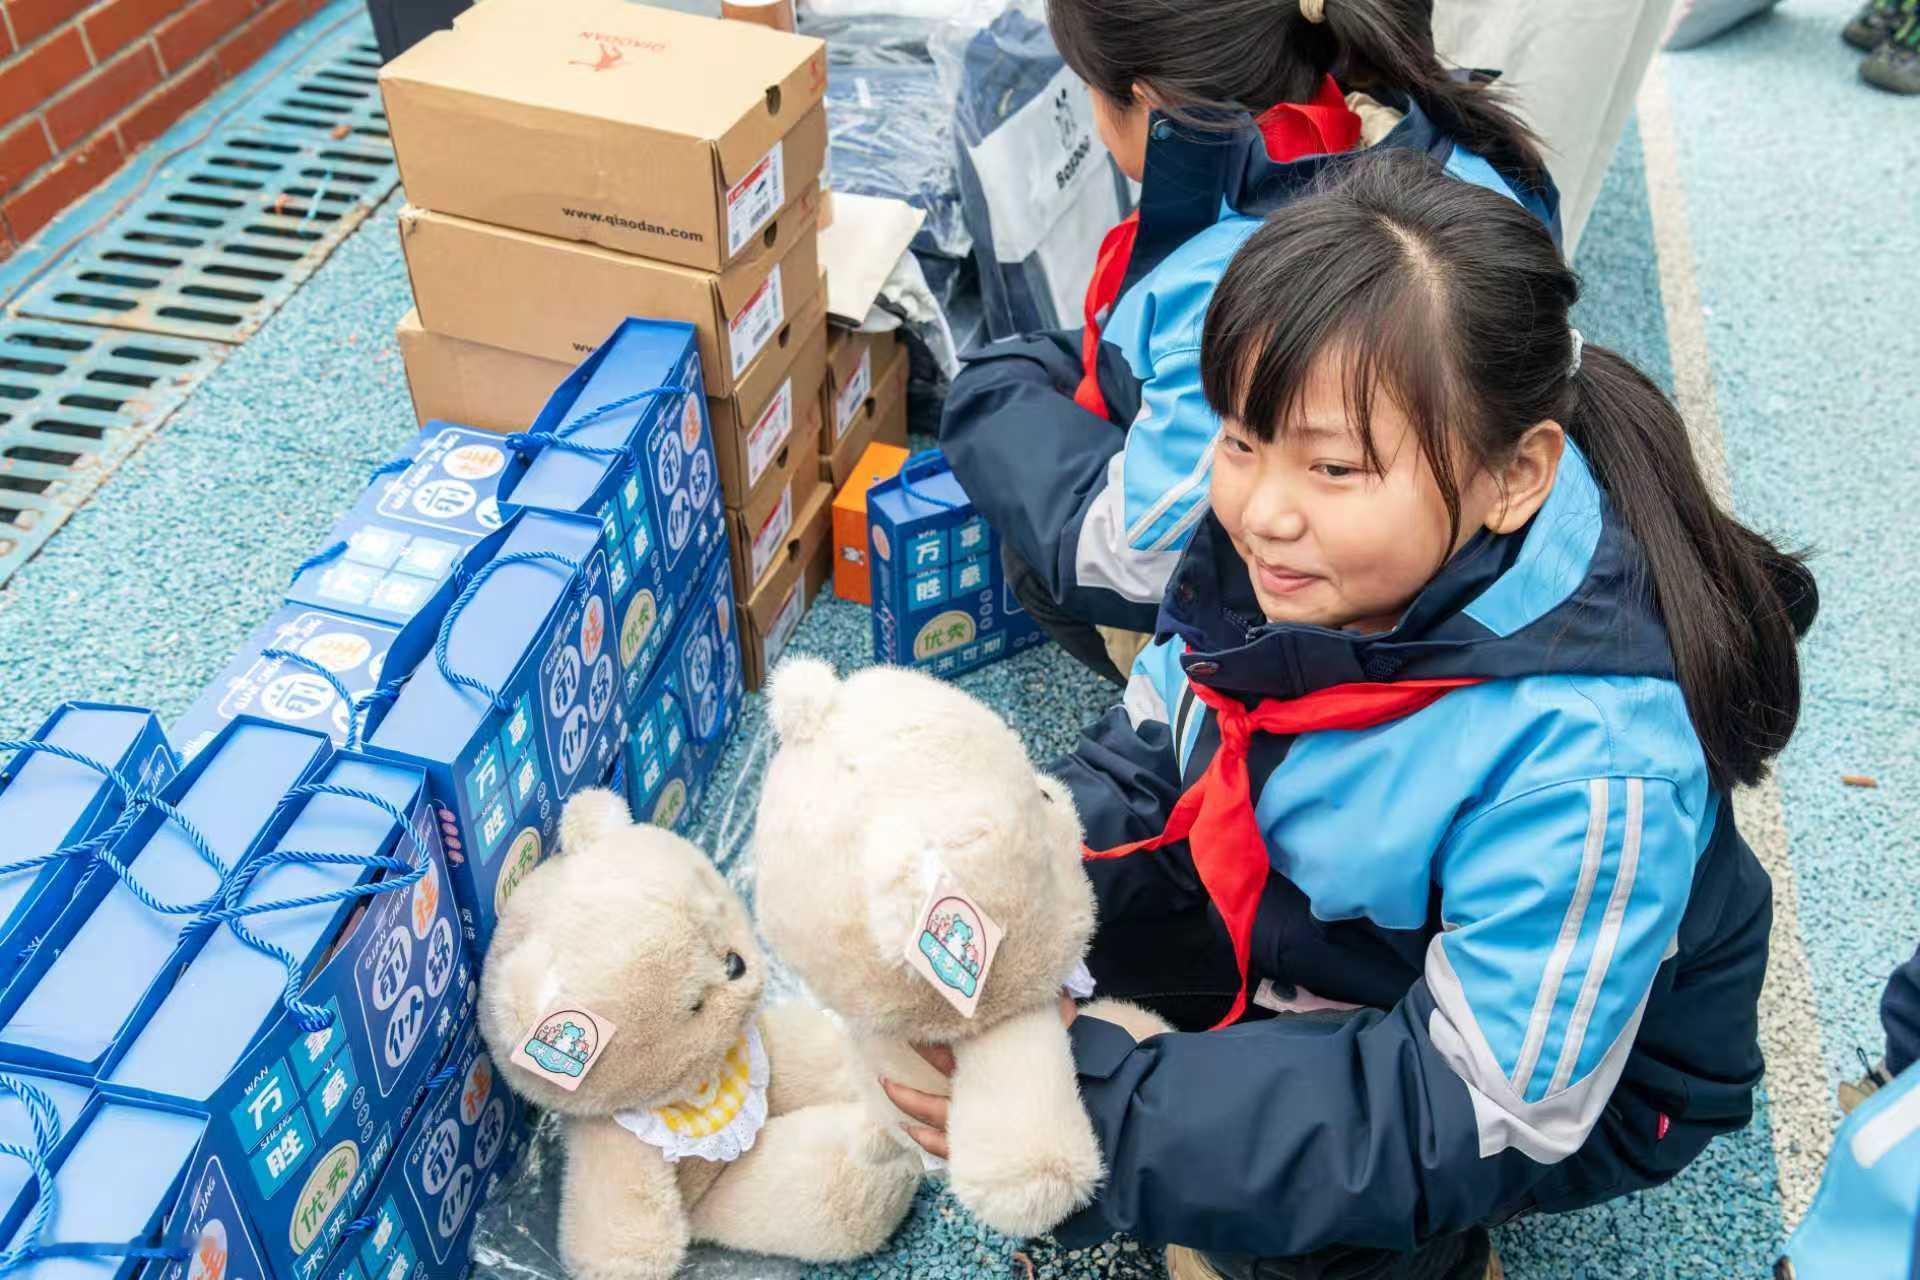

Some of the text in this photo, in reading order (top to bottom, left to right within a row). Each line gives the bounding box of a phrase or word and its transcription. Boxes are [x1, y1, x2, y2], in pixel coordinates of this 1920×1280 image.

[562, 207, 704, 242] www.qiaodan.com
[364, 930, 388, 970] QIAN
[244, 1066, 270, 1096] WAN
[247, 1076, 283, 1131] 万
[259, 1115, 293, 1151] SHENG
[266, 1128, 304, 1180] 胜
[300, 1155, 349, 1233] 优秀
